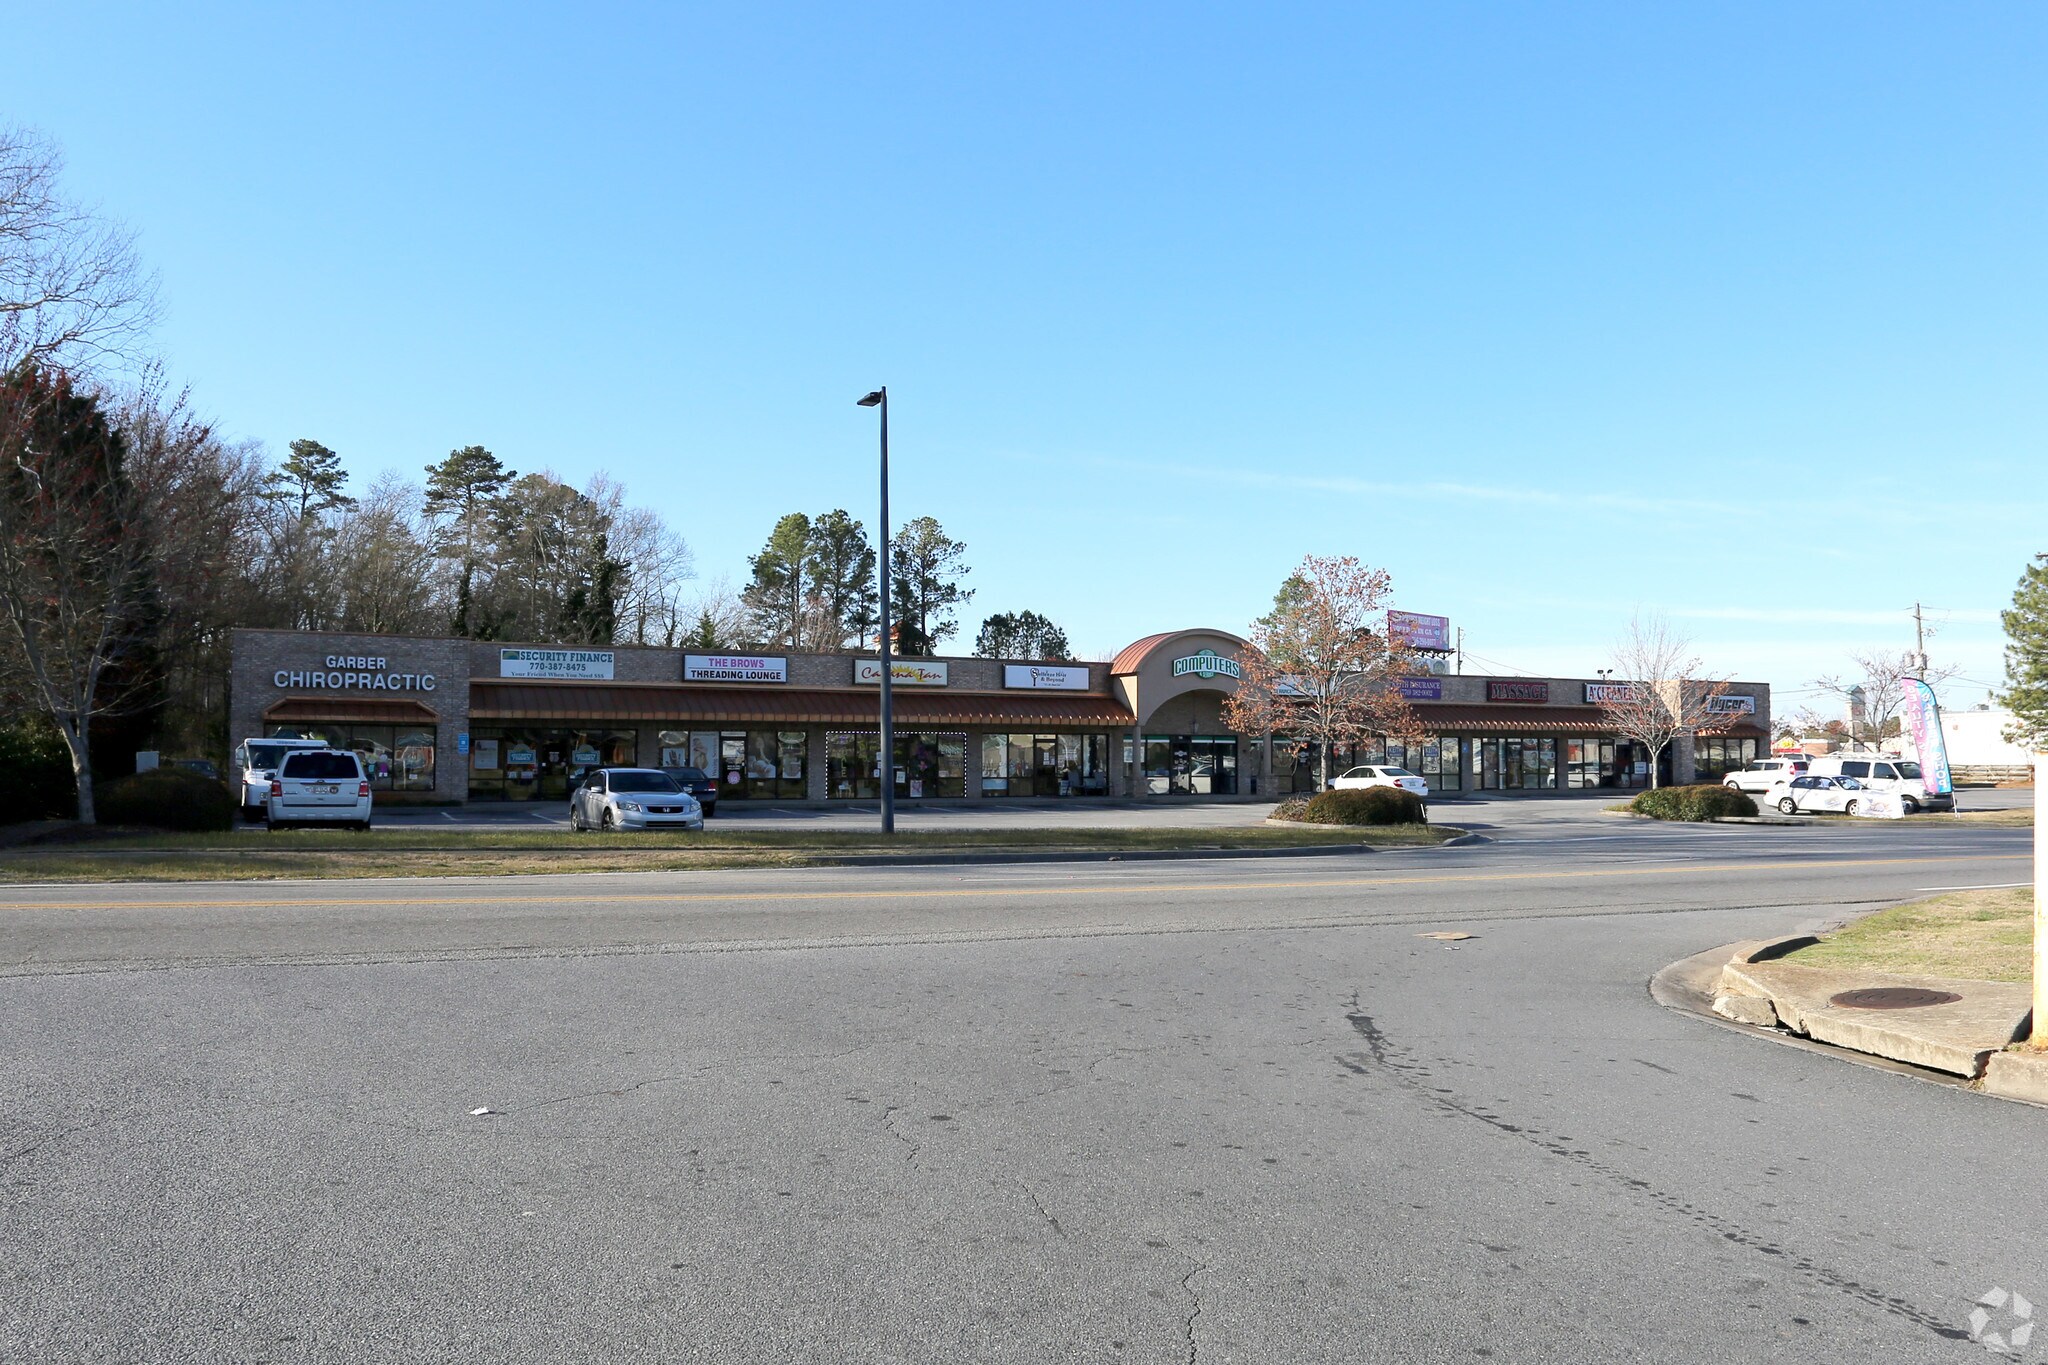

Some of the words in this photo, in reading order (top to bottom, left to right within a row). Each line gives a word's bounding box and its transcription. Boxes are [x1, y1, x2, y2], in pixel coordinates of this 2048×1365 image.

[326, 655, 386, 669] GARBER
[520, 651, 567, 661] SECURITY
[570, 652, 613, 663] FINANCE
[709, 658, 727, 667] THE
[731, 659, 765, 668] BROWS
[530, 662, 586, 671] 770-387-8475
[1175, 656, 1239, 676] COMPUTERS
[691, 670, 743, 679] THREADING
[746, 671, 781, 680] LOUNGE
[917, 668, 943, 680] Tan
[274, 671, 436, 691] CHIROPRACTIC
[1491, 684, 1547, 699] MASSAGE
